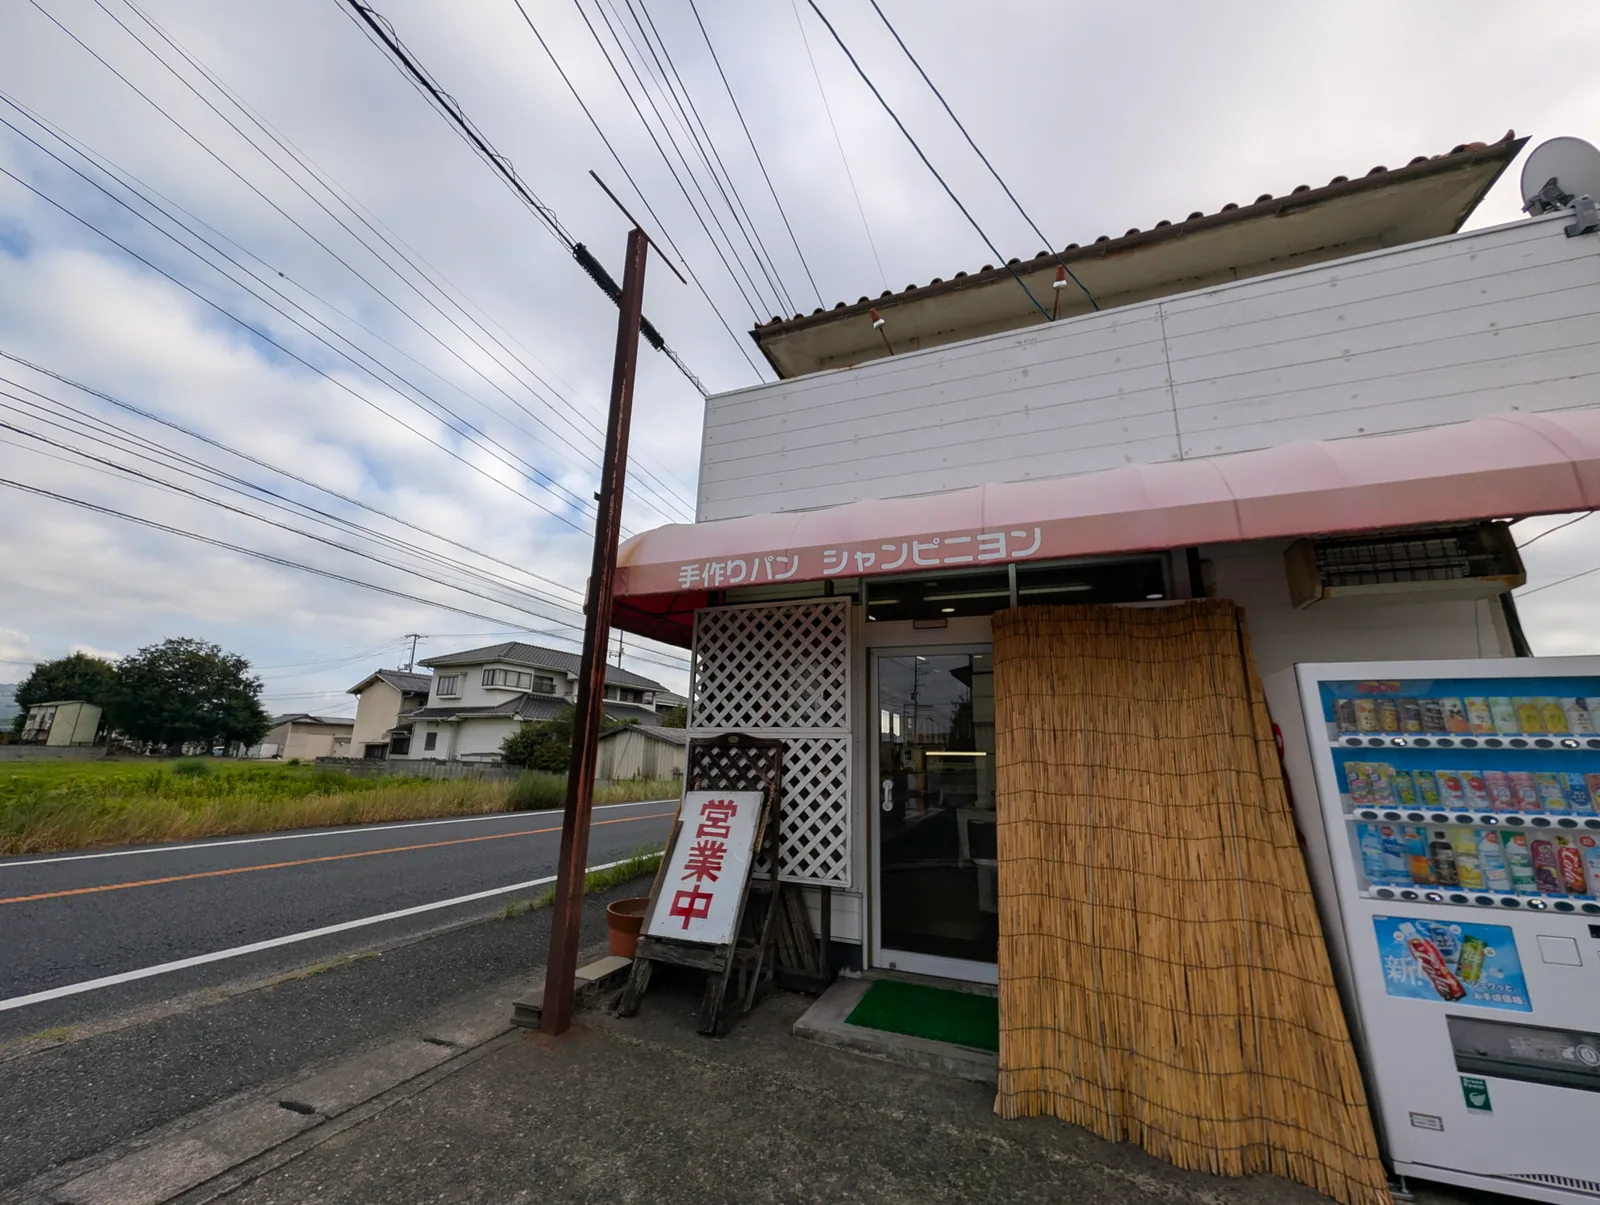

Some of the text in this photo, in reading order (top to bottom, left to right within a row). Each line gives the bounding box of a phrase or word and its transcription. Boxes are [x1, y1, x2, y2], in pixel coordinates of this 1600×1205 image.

[678, 527, 1042, 591] 手作りパン シャンピニヨン
[668, 799, 739, 931] 営業中
